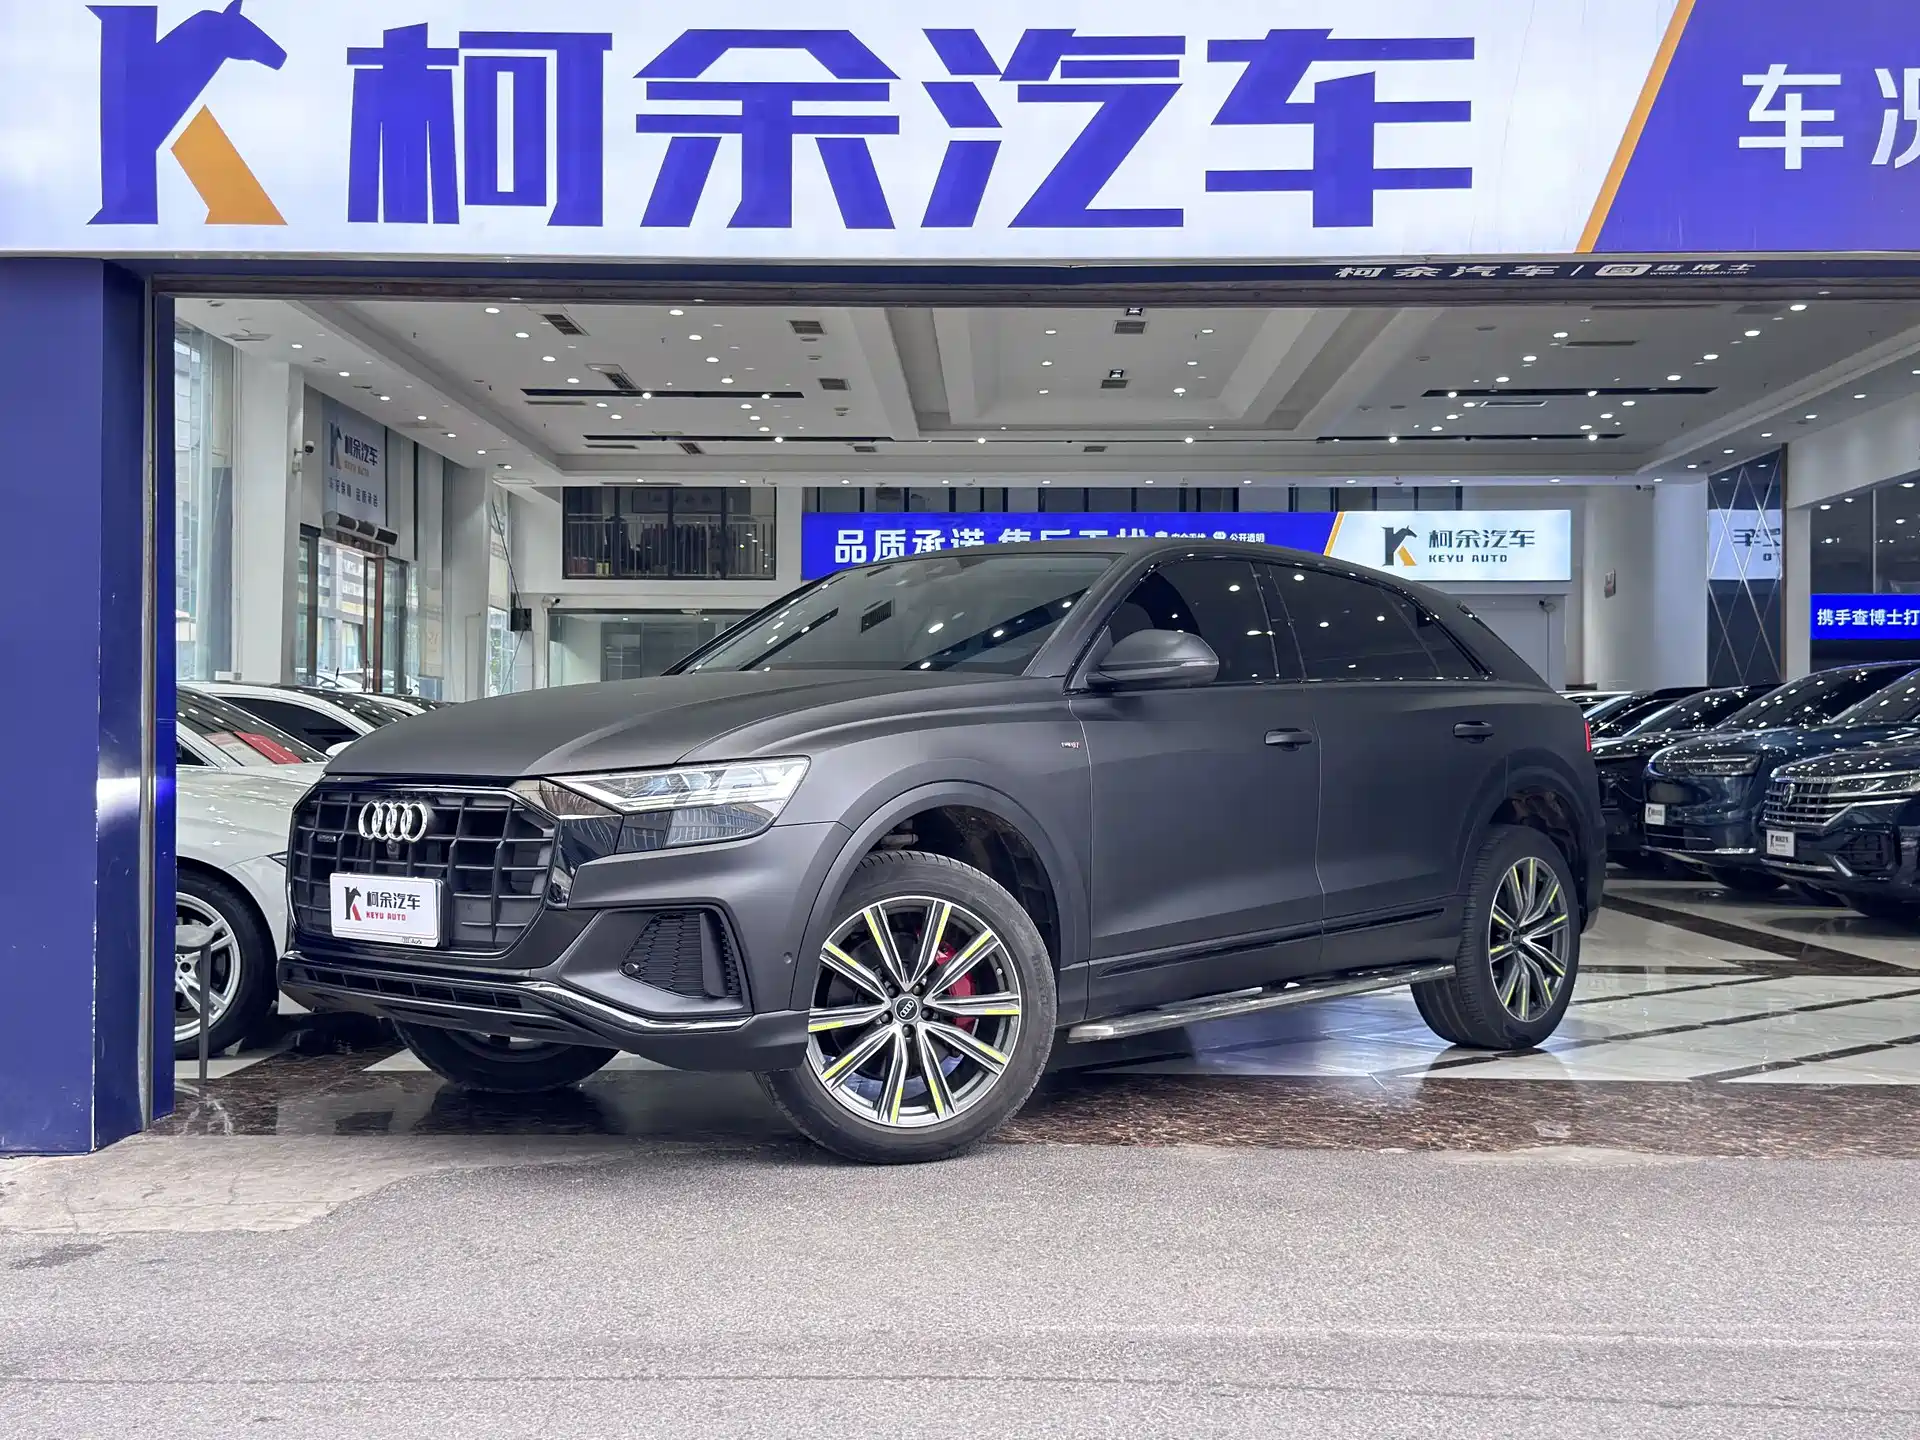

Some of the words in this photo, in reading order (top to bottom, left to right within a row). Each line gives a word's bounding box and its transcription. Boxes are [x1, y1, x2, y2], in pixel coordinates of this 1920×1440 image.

[346, 22, 1476, 229] 柯余汽车
[1335, 264, 1560, 278] 柯余汽车
[1229, 532, 1265, 544] 公开透明
[1428, 529, 1536, 549] 柯余汽车
[1428, 554, 1464, 563] KEYU
[1471, 554, 1508, 563] AUTO
[1816, 608, 1920, 627] 携手查博士打
[366, 890, 421, 911] 柯余汽车
[366, 911, 385, 920] KEYU
[387, 912, 407, 921] AUTO
